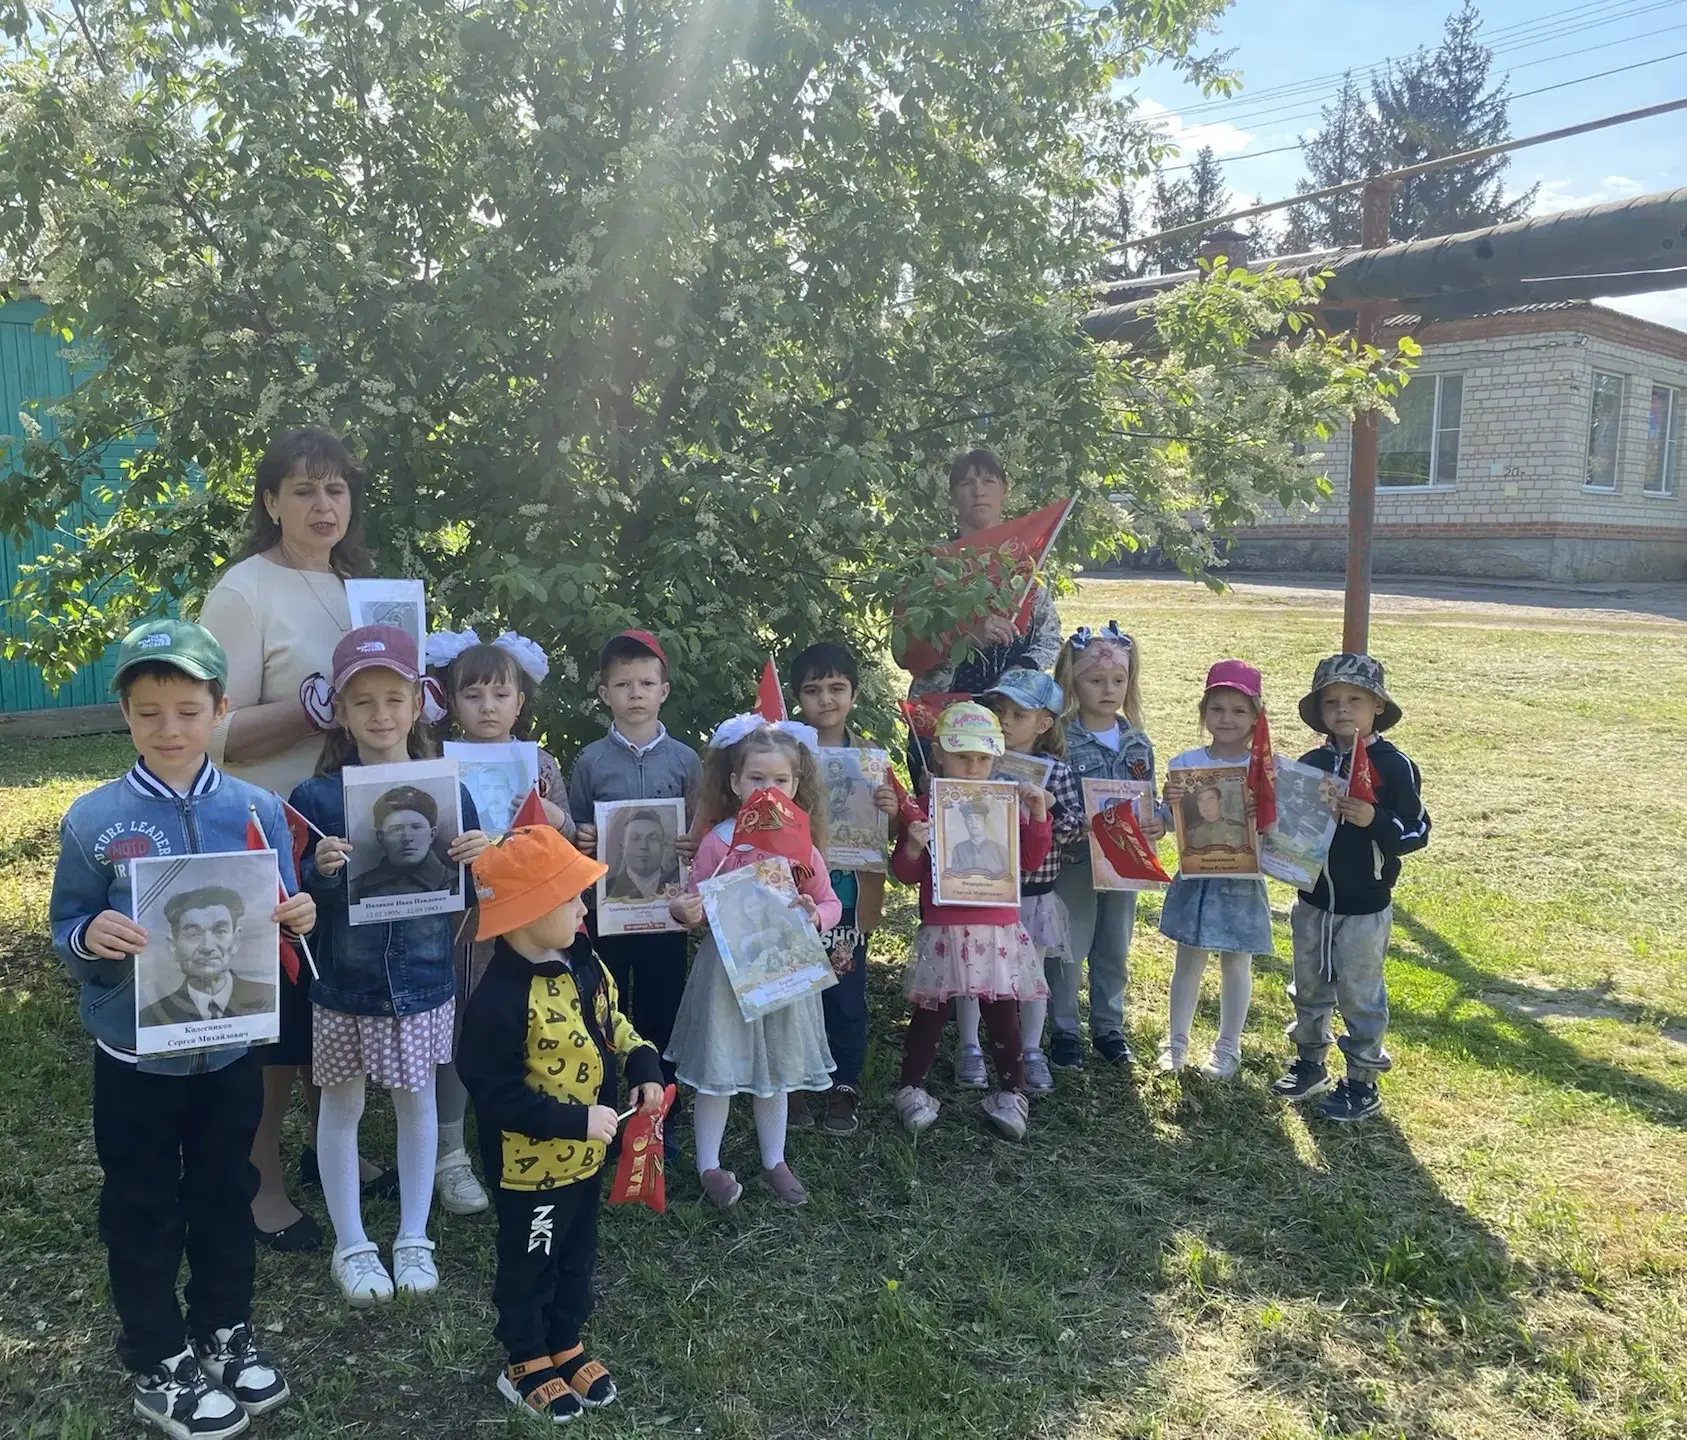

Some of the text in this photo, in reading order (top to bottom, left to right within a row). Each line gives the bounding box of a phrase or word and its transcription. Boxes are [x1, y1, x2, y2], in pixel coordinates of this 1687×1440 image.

[130, 820, 172, 856] LEADER
[185, 1023, 233, 1034] Колесников
[167, 1032, 249, 1047] Сергей Михайлович
